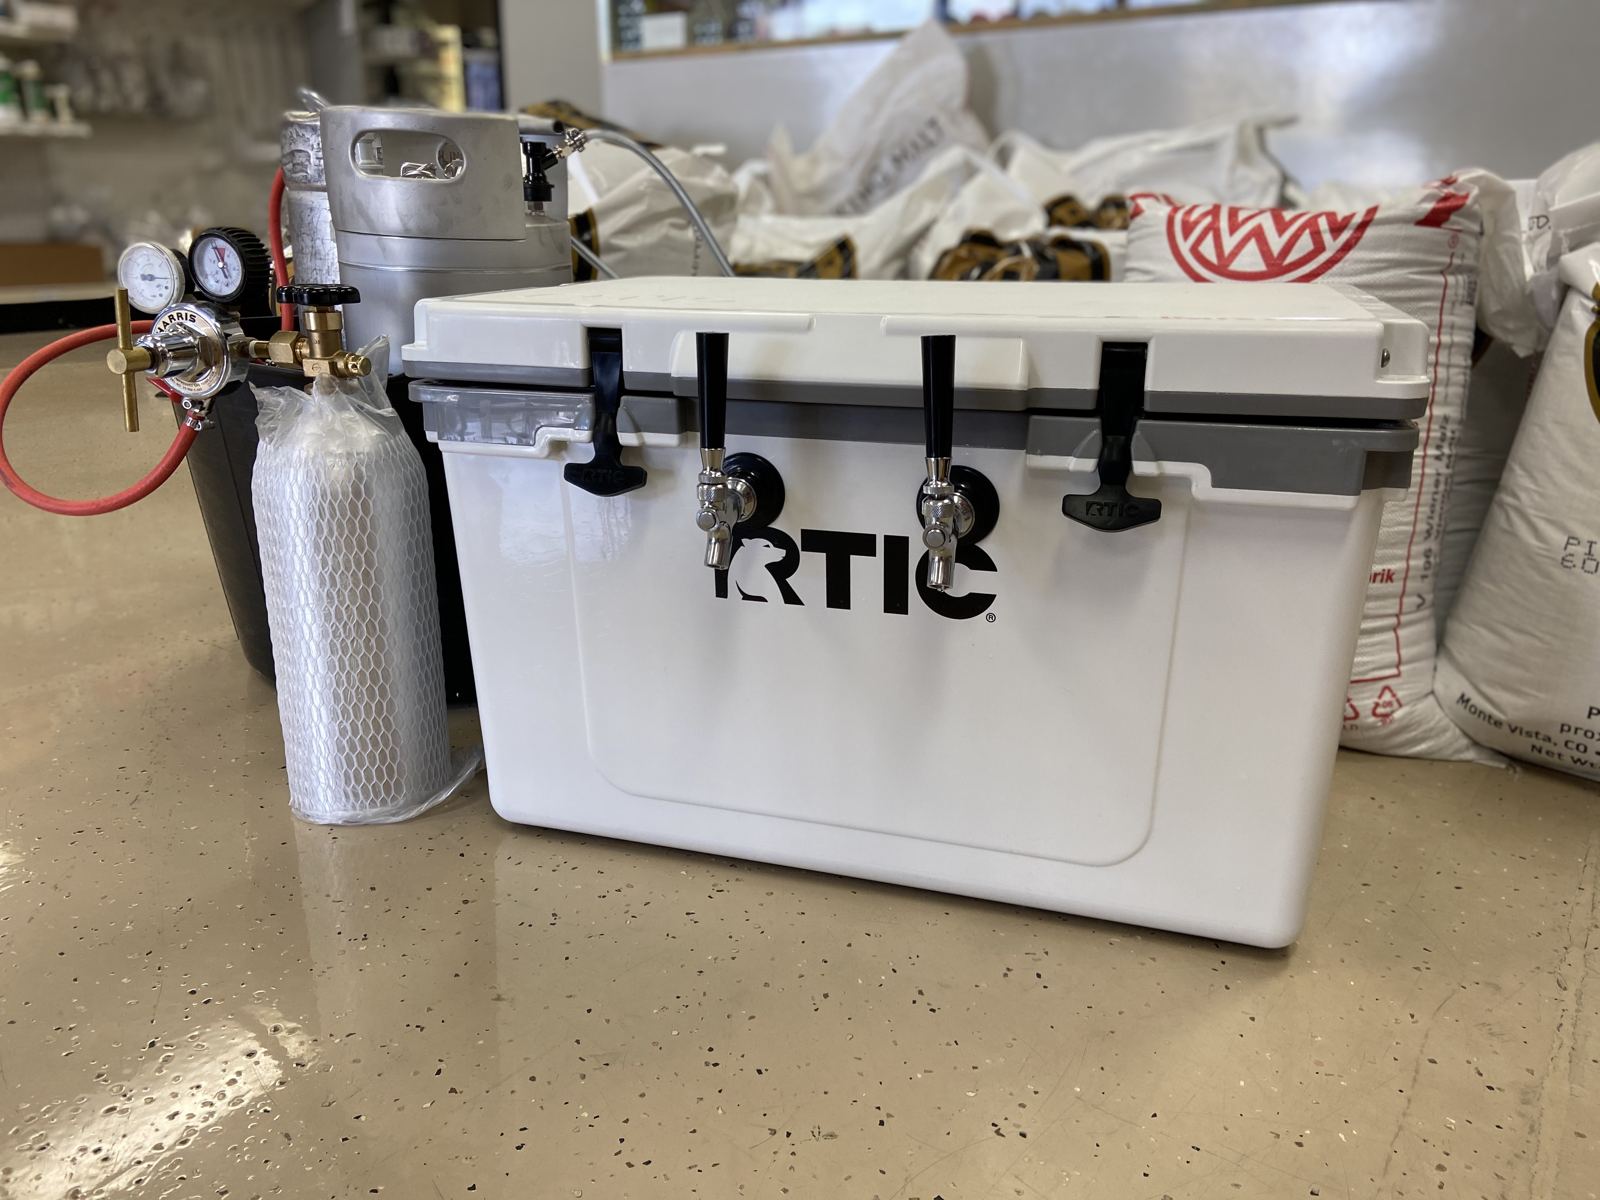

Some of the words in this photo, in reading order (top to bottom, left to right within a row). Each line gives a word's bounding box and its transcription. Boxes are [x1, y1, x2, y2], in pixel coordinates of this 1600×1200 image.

[1086, 501, 1140, 517] RTIC
[1424, 468, 1442, 541] Wiener
[714, 525, 998, 620] RTIC
[1369, 568, 1396, 583] rik
[1456, 692, 1503, 729] Monte
[1507, 723, 1558, 746] Vista,
[1563, 739, 1588, 755] CO
[1531, 744, 1565, 761] Net
